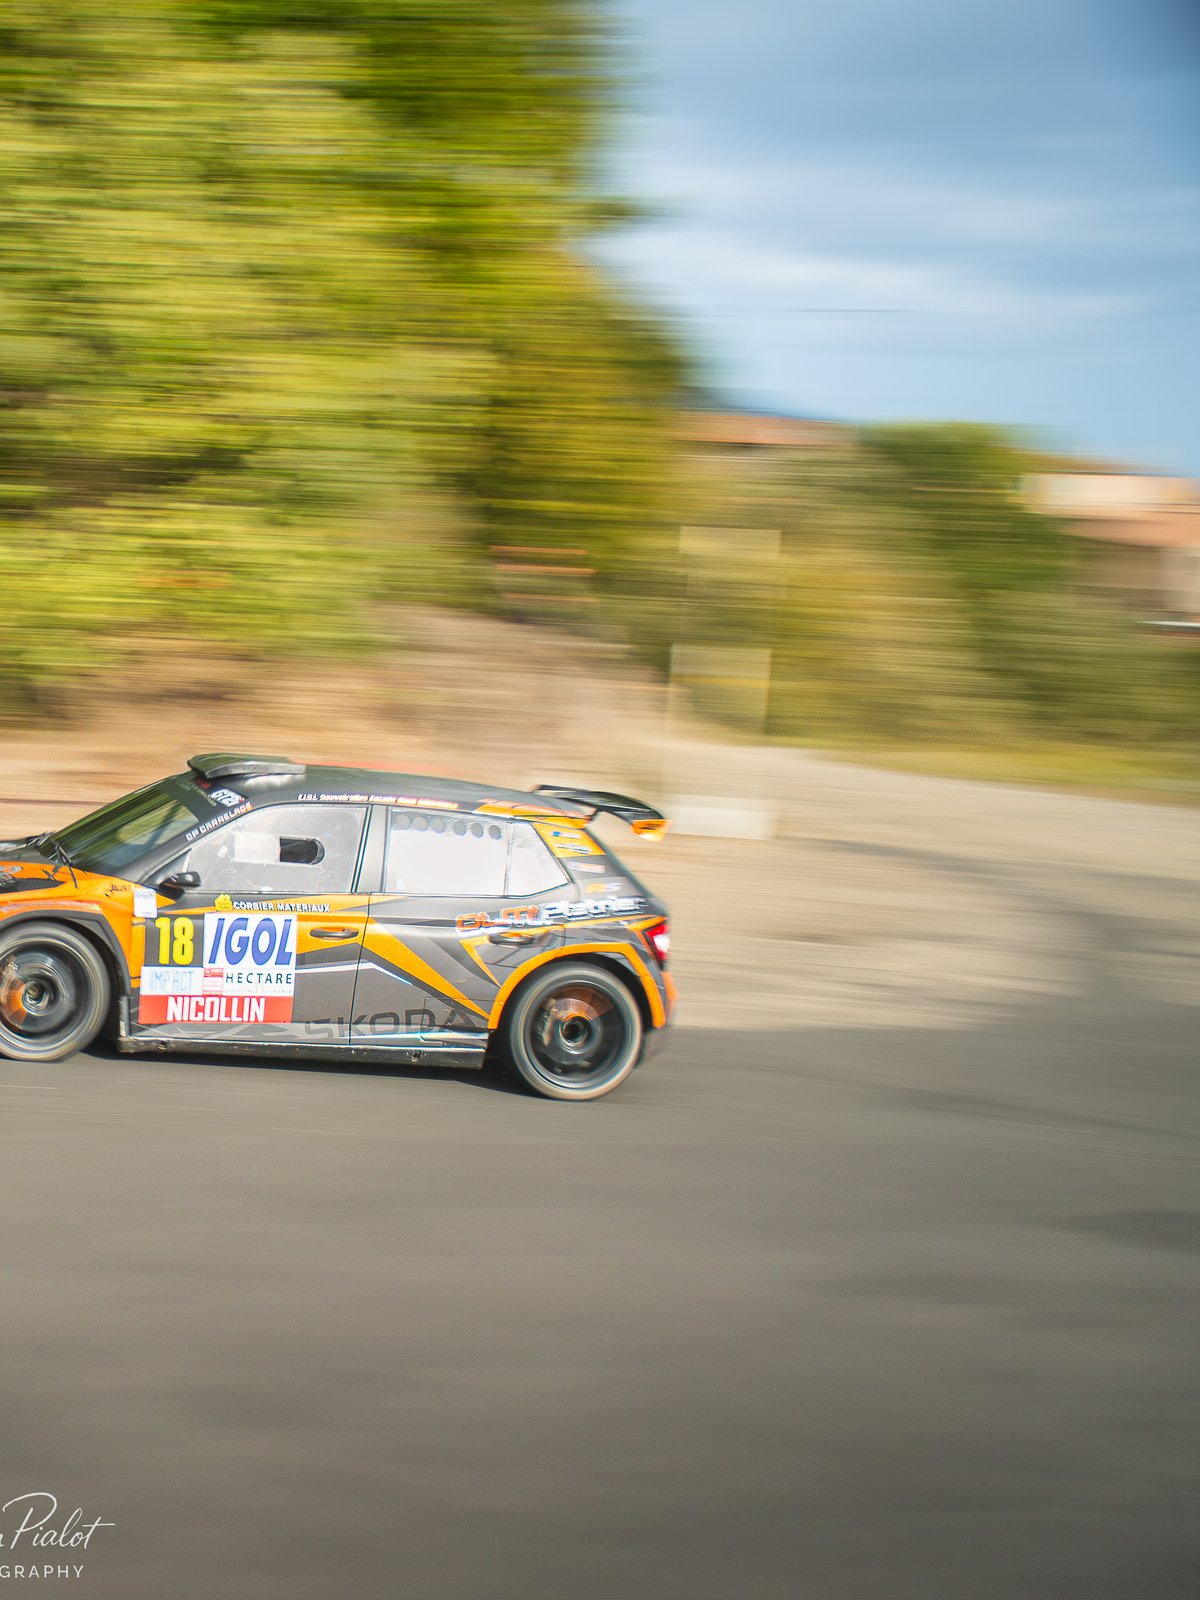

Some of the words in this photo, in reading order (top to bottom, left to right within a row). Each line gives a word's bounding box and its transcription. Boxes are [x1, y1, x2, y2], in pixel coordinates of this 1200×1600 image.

[233, 901, 275, 911] CORBIER
[276, 902, 331, 913] MATERIAUX
[155, 917, 194, 965] 18
[208, 917, 293, 966] IGOL
[150, 970, 195, 993] IMPACT
[225, 973, 292, 984] HECTARE
[166, 996, 266, 1022] NICOLLIN
